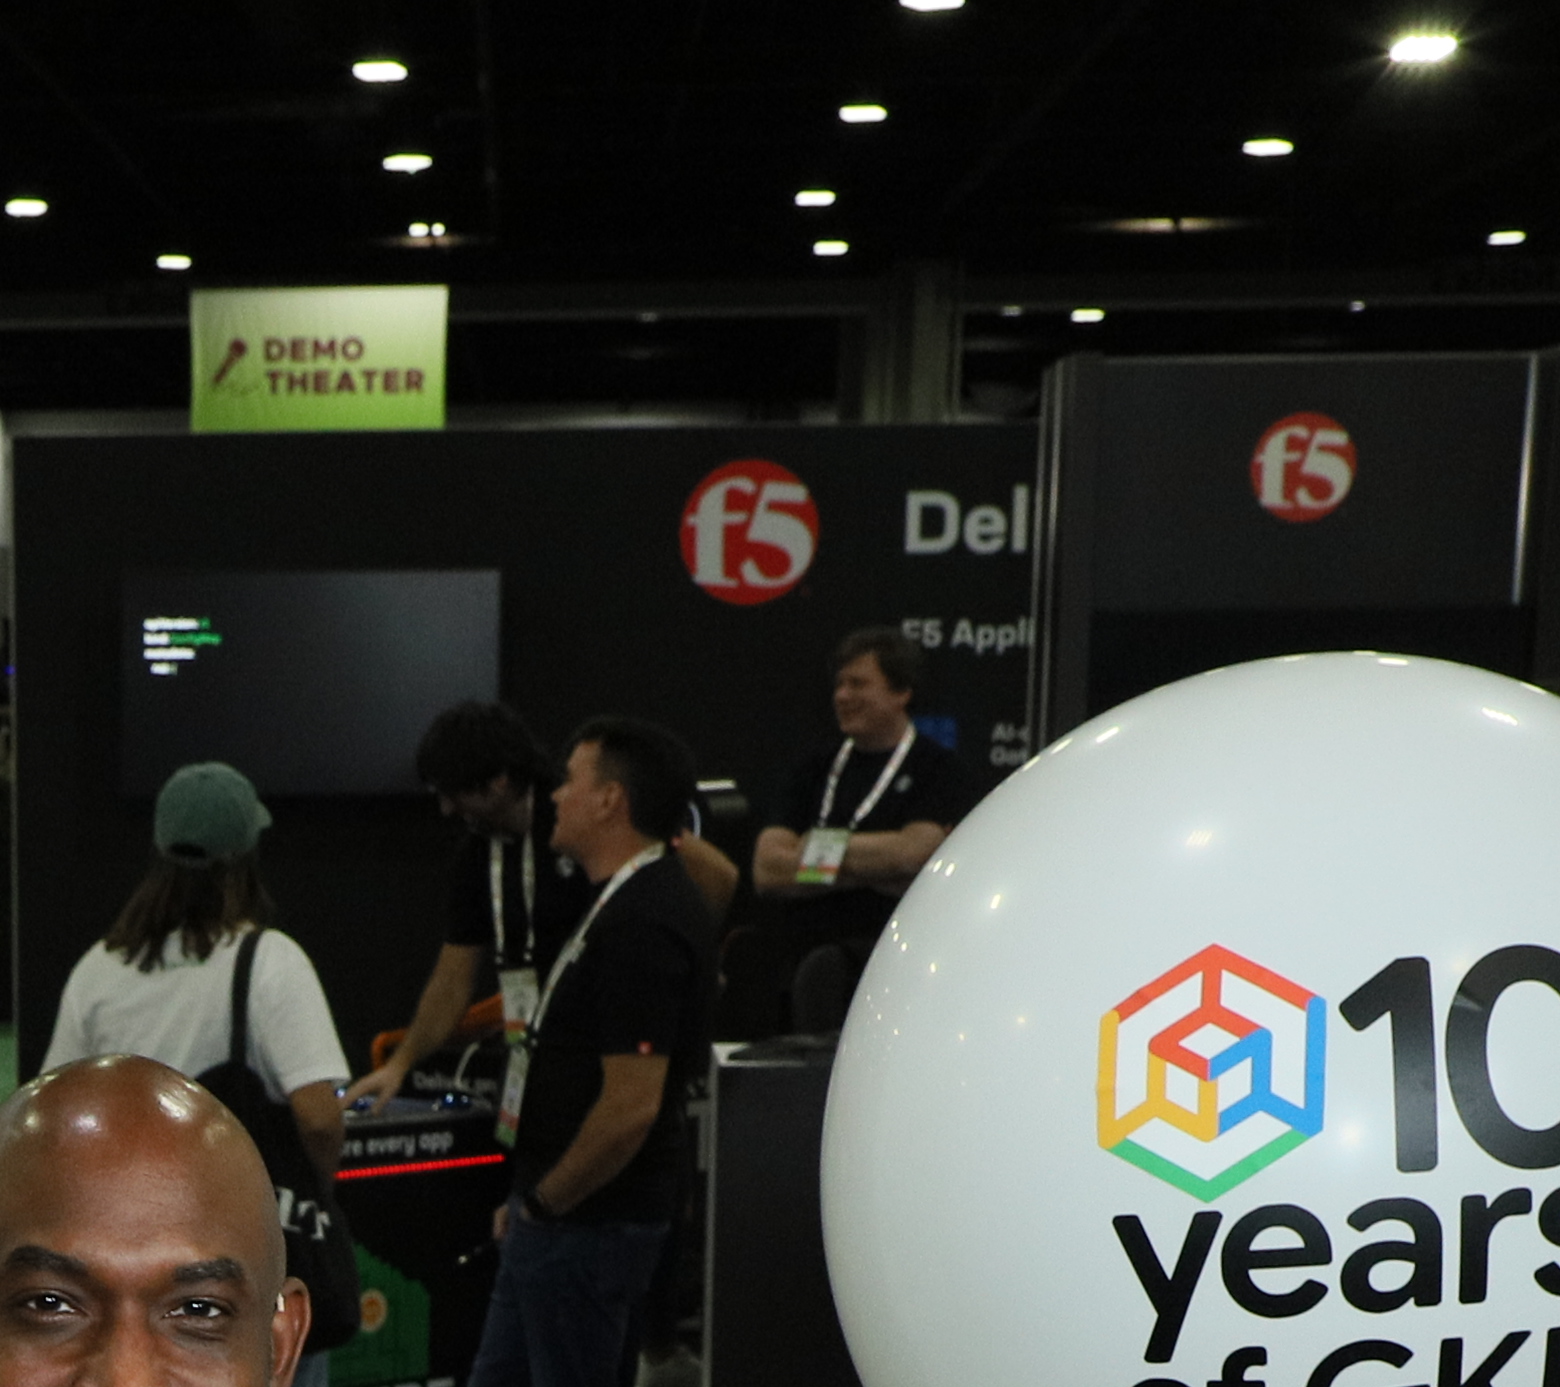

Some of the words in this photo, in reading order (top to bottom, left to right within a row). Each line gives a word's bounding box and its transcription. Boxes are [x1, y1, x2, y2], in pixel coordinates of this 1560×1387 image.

[263, 336, 364, 362] DEMO
[264, 368, 425, 396] THEATER
[903, 484, 1029, 555] Del
[367, 1134, 416, 1158] every
[420, 1130, 454, 1154] app
